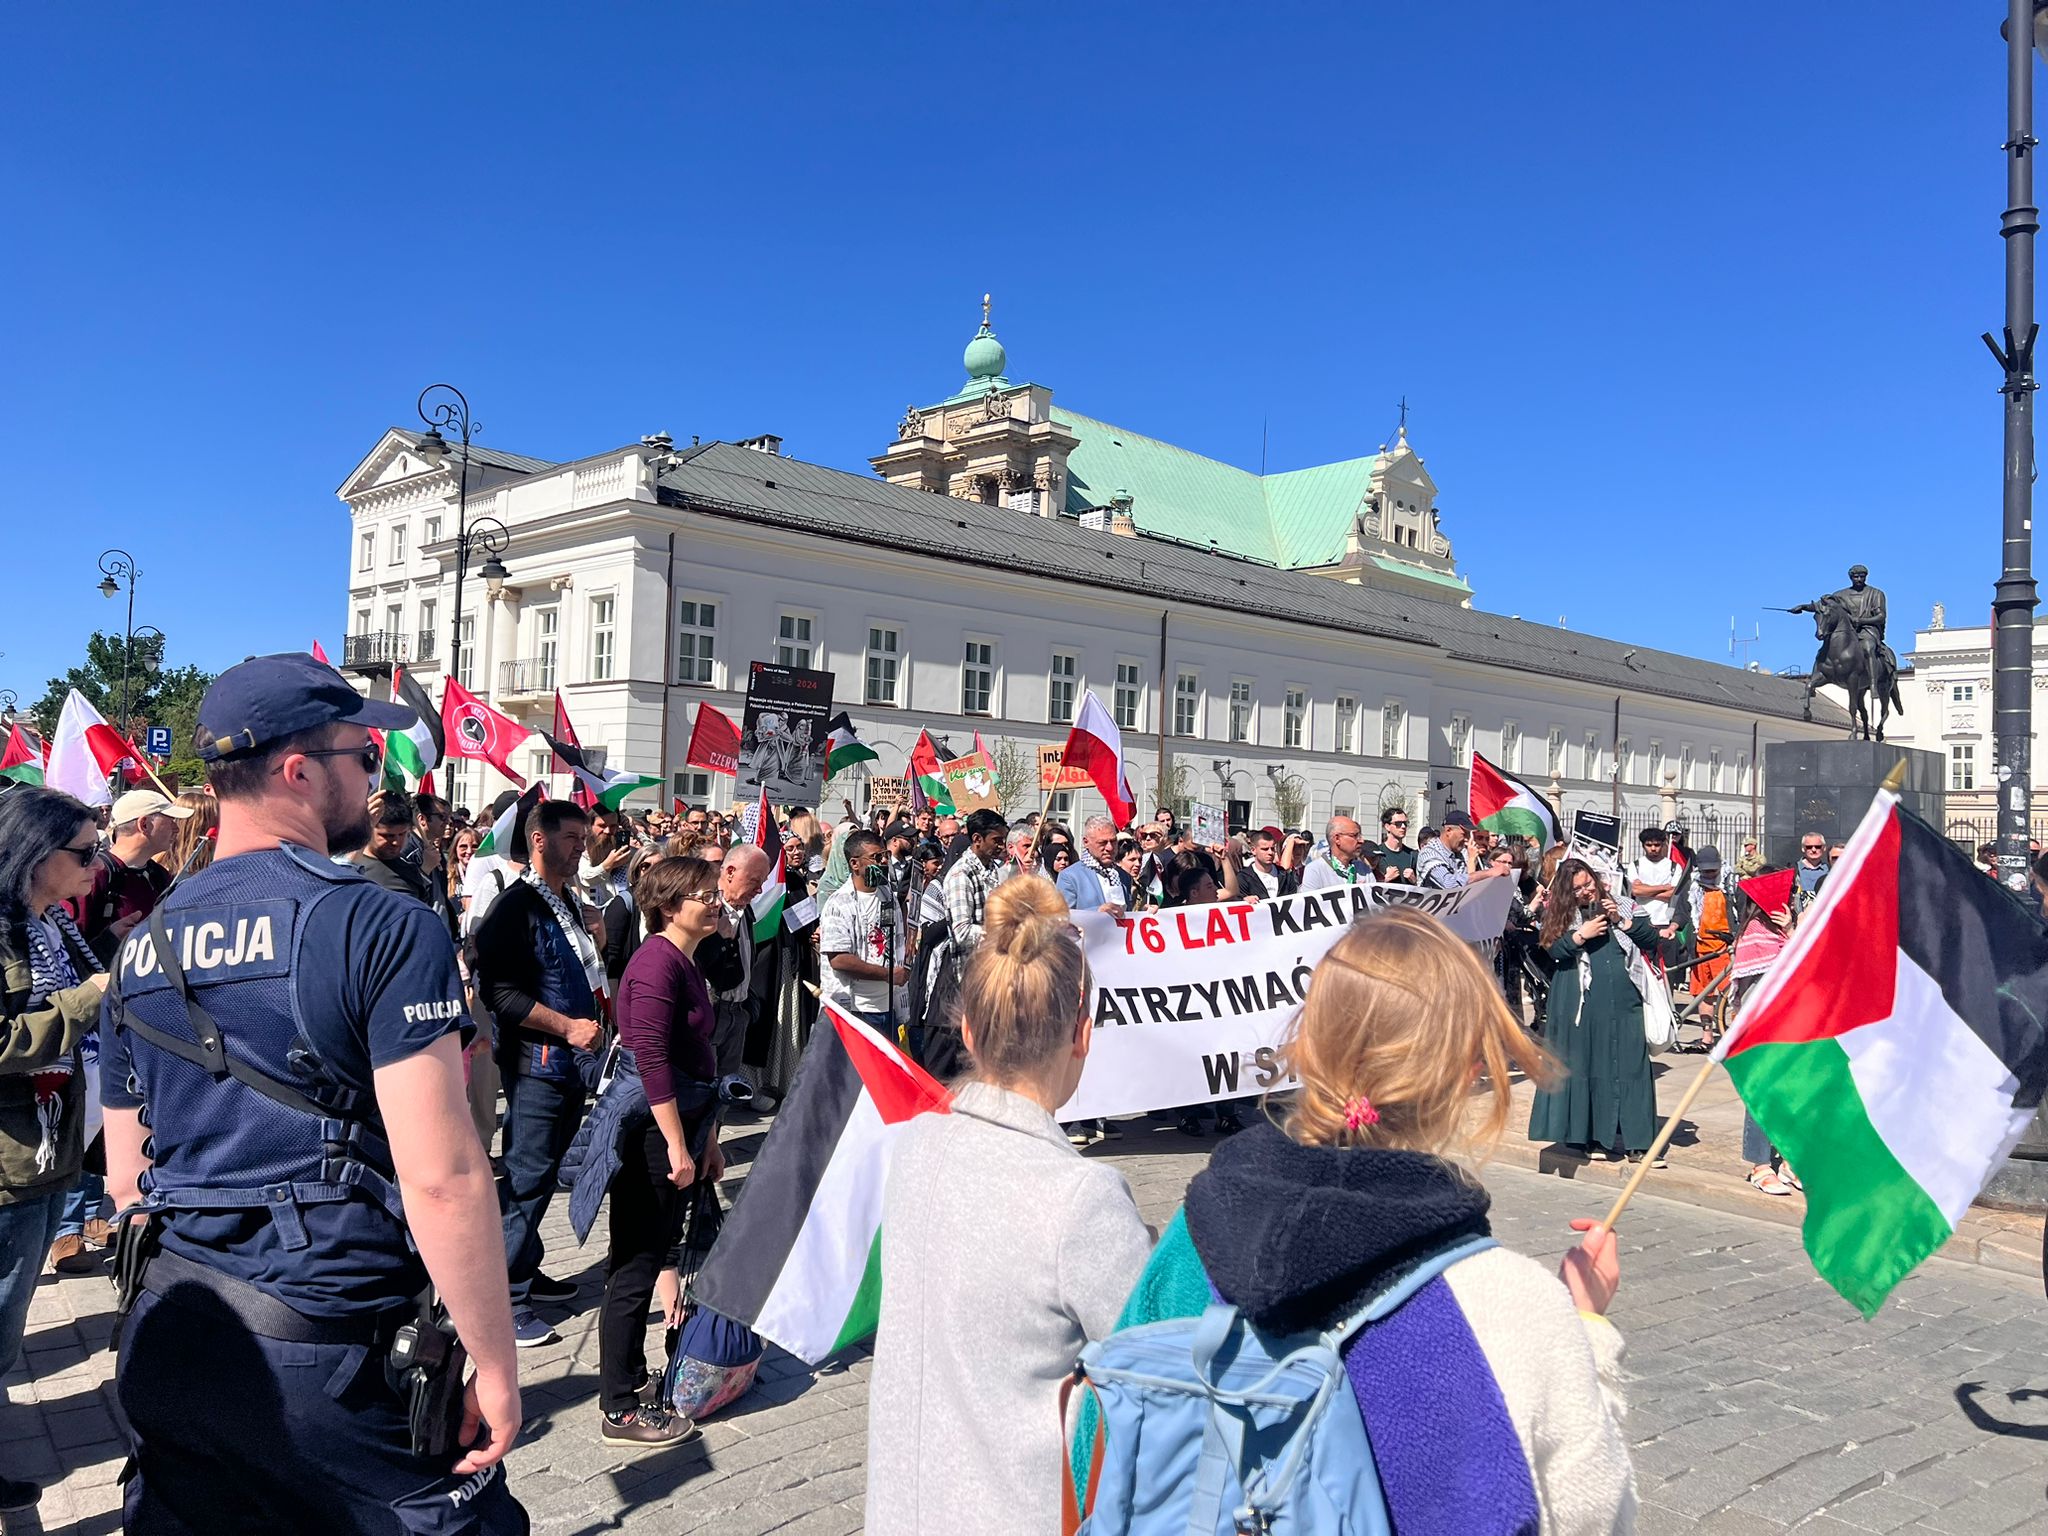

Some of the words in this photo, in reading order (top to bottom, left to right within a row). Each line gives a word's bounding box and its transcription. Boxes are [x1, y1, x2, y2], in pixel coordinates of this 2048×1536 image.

[752, 663, 763, 673] 76
[796, 680, 817, 689] 2024
[152, 729, 167, 746] P
[872, 777, 890, 788] HOW
[1116, 917, 1166, 955] 76
[1176, 905, 1255, 950] LAT
[121, 916, 275, 982] POICJA
[1094, 957, 1314, 1029] ATRZYMAĆ
[403, 1000, 462, 1023] POLICJA
[1202, 1051, 1239, 1096] W
